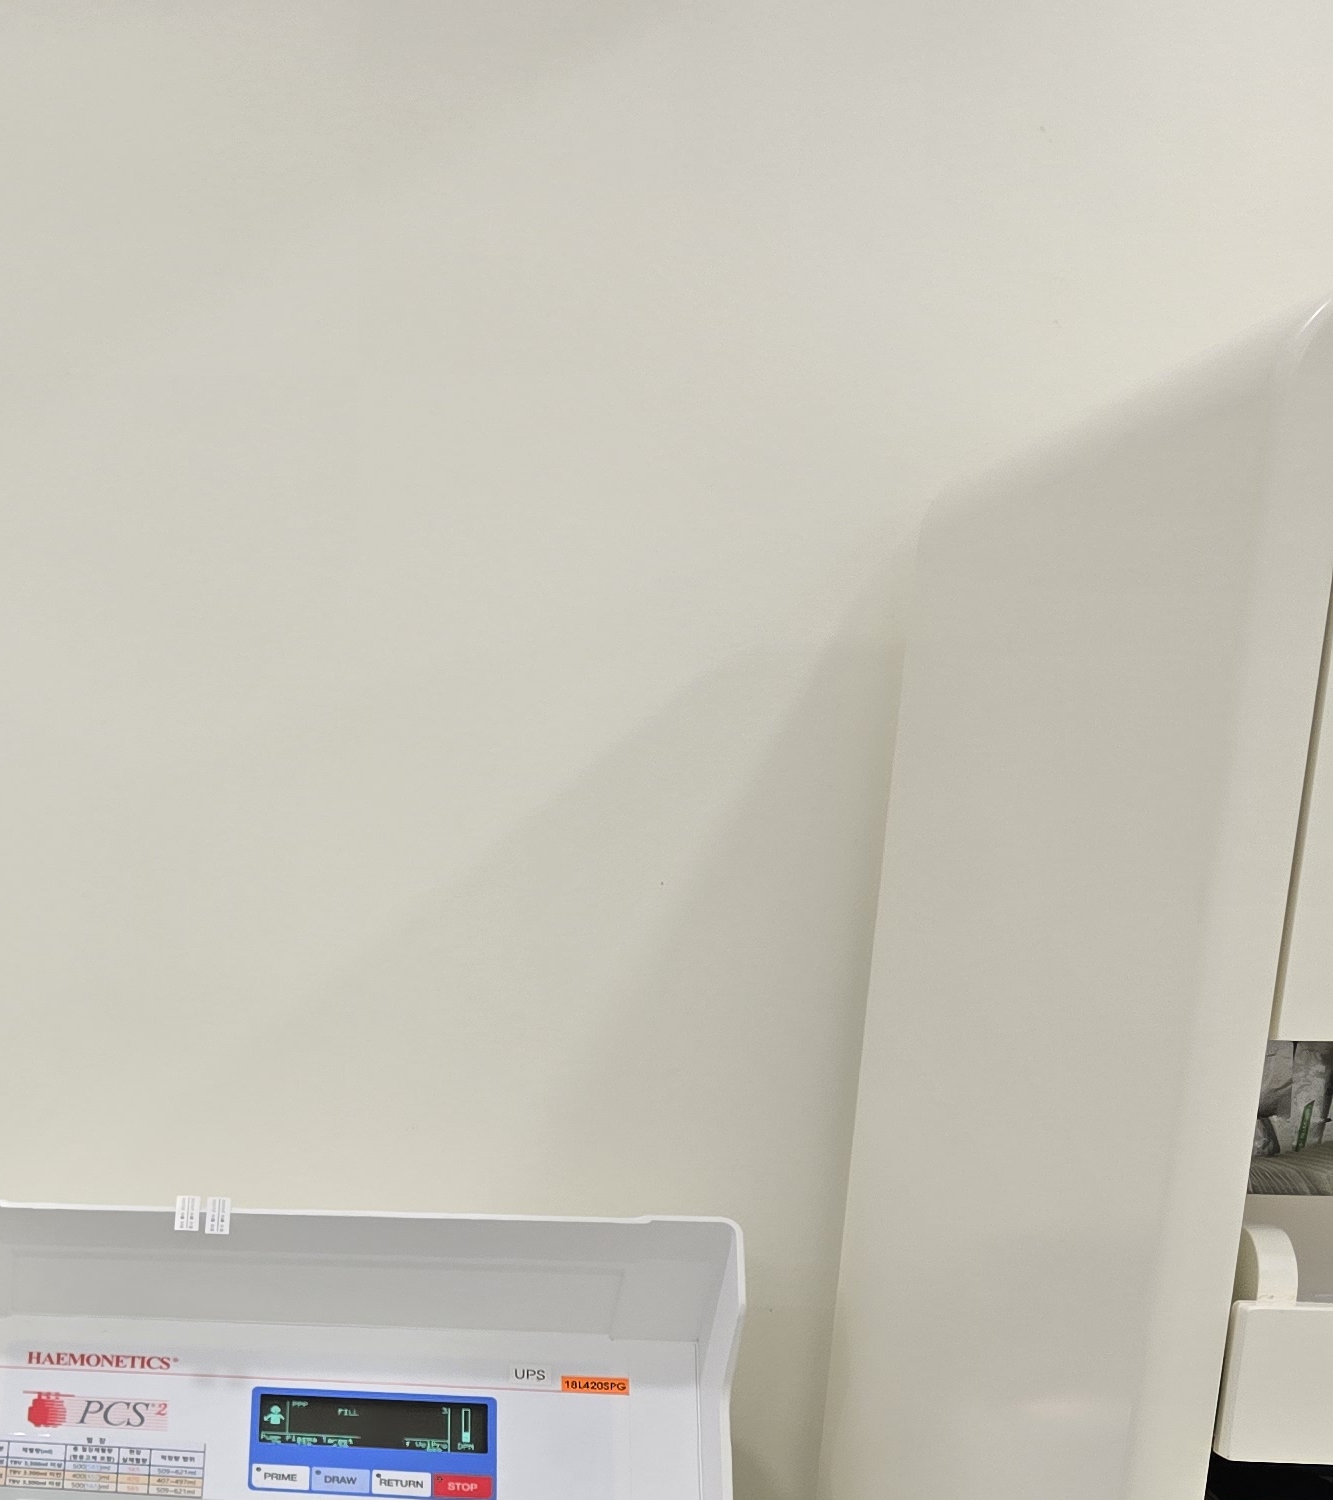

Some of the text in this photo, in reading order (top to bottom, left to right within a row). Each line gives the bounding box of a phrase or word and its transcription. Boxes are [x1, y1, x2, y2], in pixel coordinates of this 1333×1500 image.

[27, 1351, 171, 1370] HAEMONETICS
[514, 1368, 546, 1381] UPS
[564, 1380, 627, 1391] 18L420SPG
[337, 1408, 360, 1417] FILL
[263, 1472, 297, 1483] PRIME
[324, 1475, 357, 1485] DRAW
[379, 1478, 424, 1489] RETURN
[447, 1482, 478, 1492] STOP
